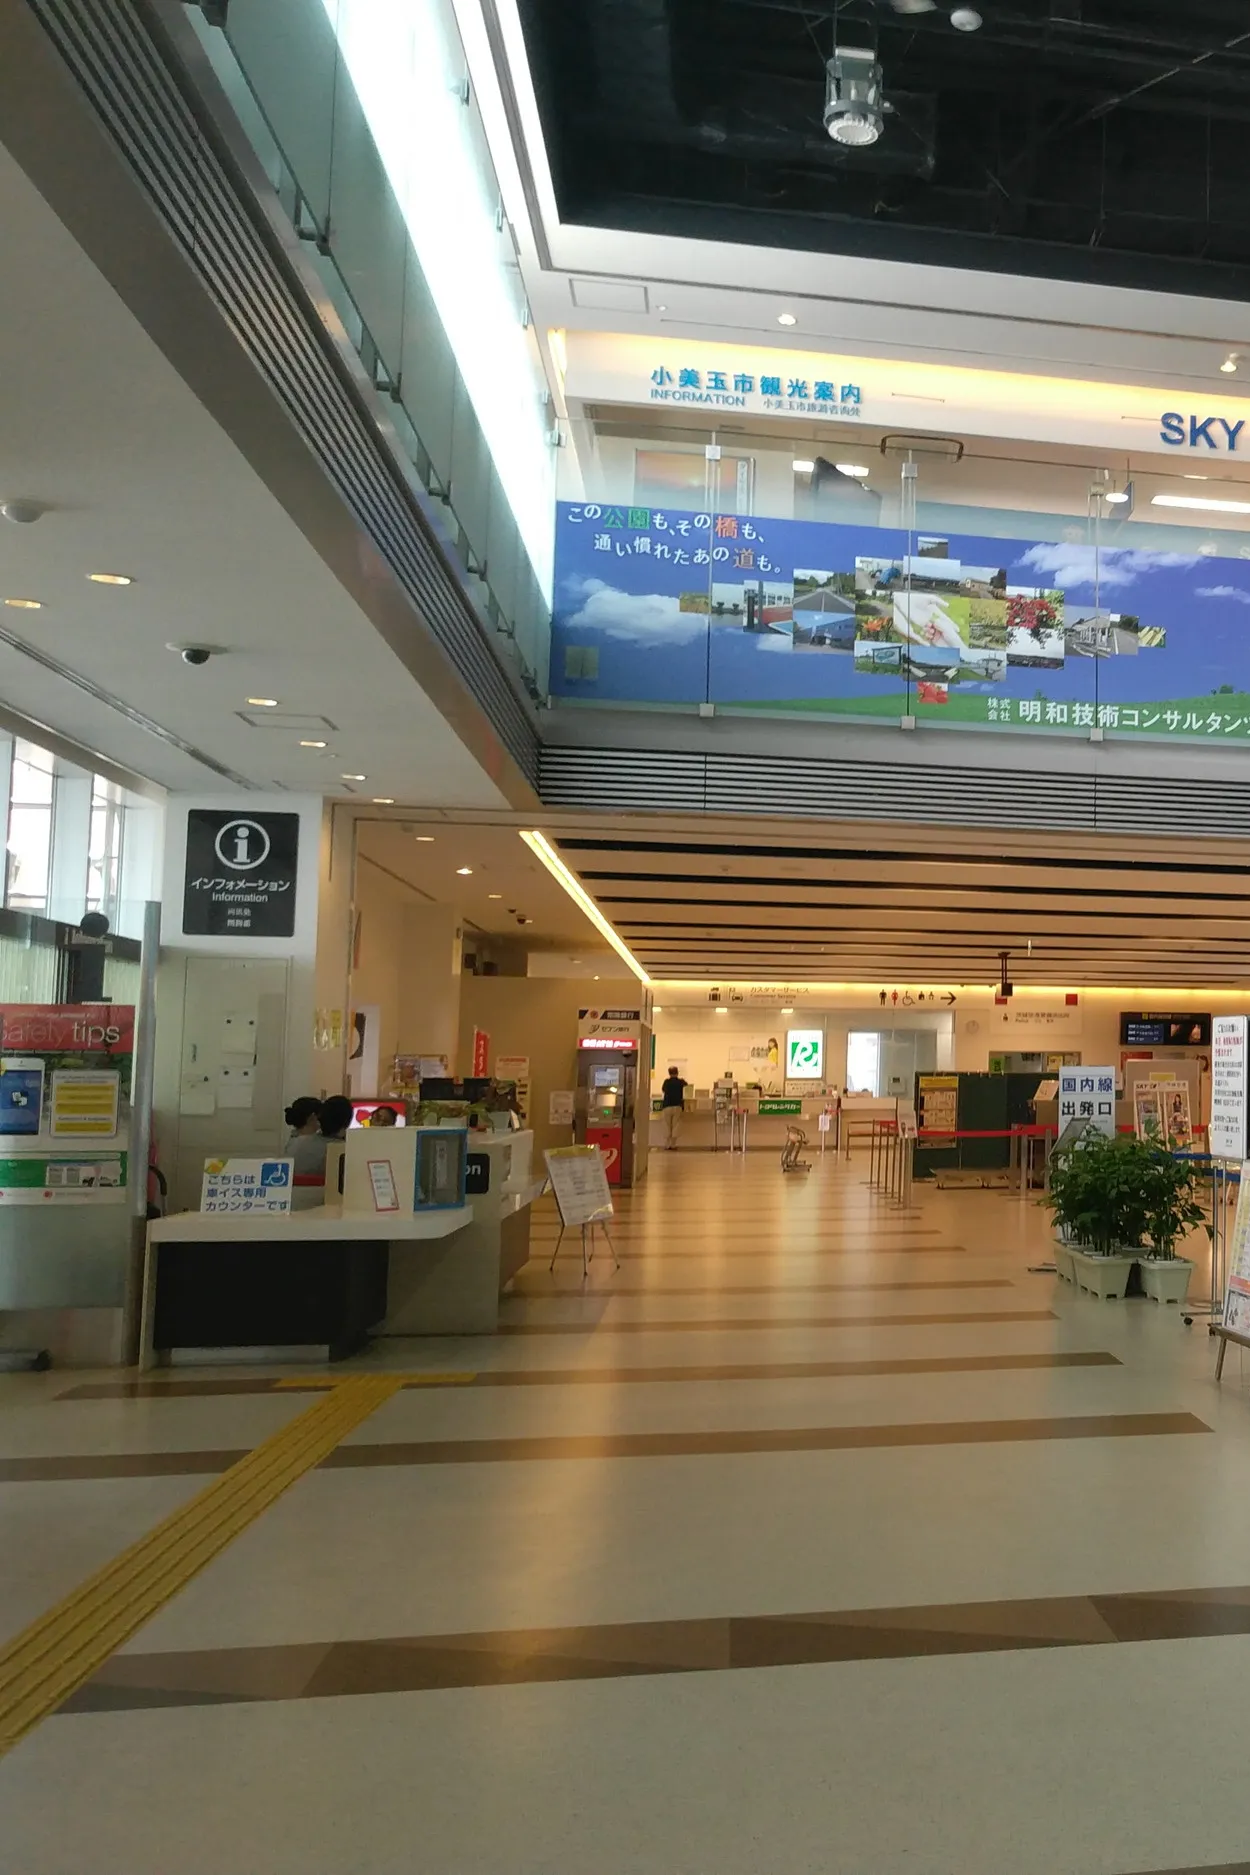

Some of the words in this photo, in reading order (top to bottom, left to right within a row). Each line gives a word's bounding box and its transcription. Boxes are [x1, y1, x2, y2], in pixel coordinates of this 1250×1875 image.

[651, 366, 861, 404] 小美玉市観光案内
[651, 389, 746, 407] INFORMATION
[1159, 411, 1247, 451] SKY
[568, 504, 765, 543] この公園も、その橋も、
[594, 533, 781, 574] 通い慣れたあの道も。
[191, 877, 290, 892] インフォメーション
[212, 892, 269, 903] Information
[72, 1019, 120, 1048] tips
[1062, 1077, 1113, 1093] 国内線
[1061, 1101, 1112, 1117] 出発口
[207, 1174, 256, 1185] こちらは
[205, 1200, 288, 1212] カウンターです
